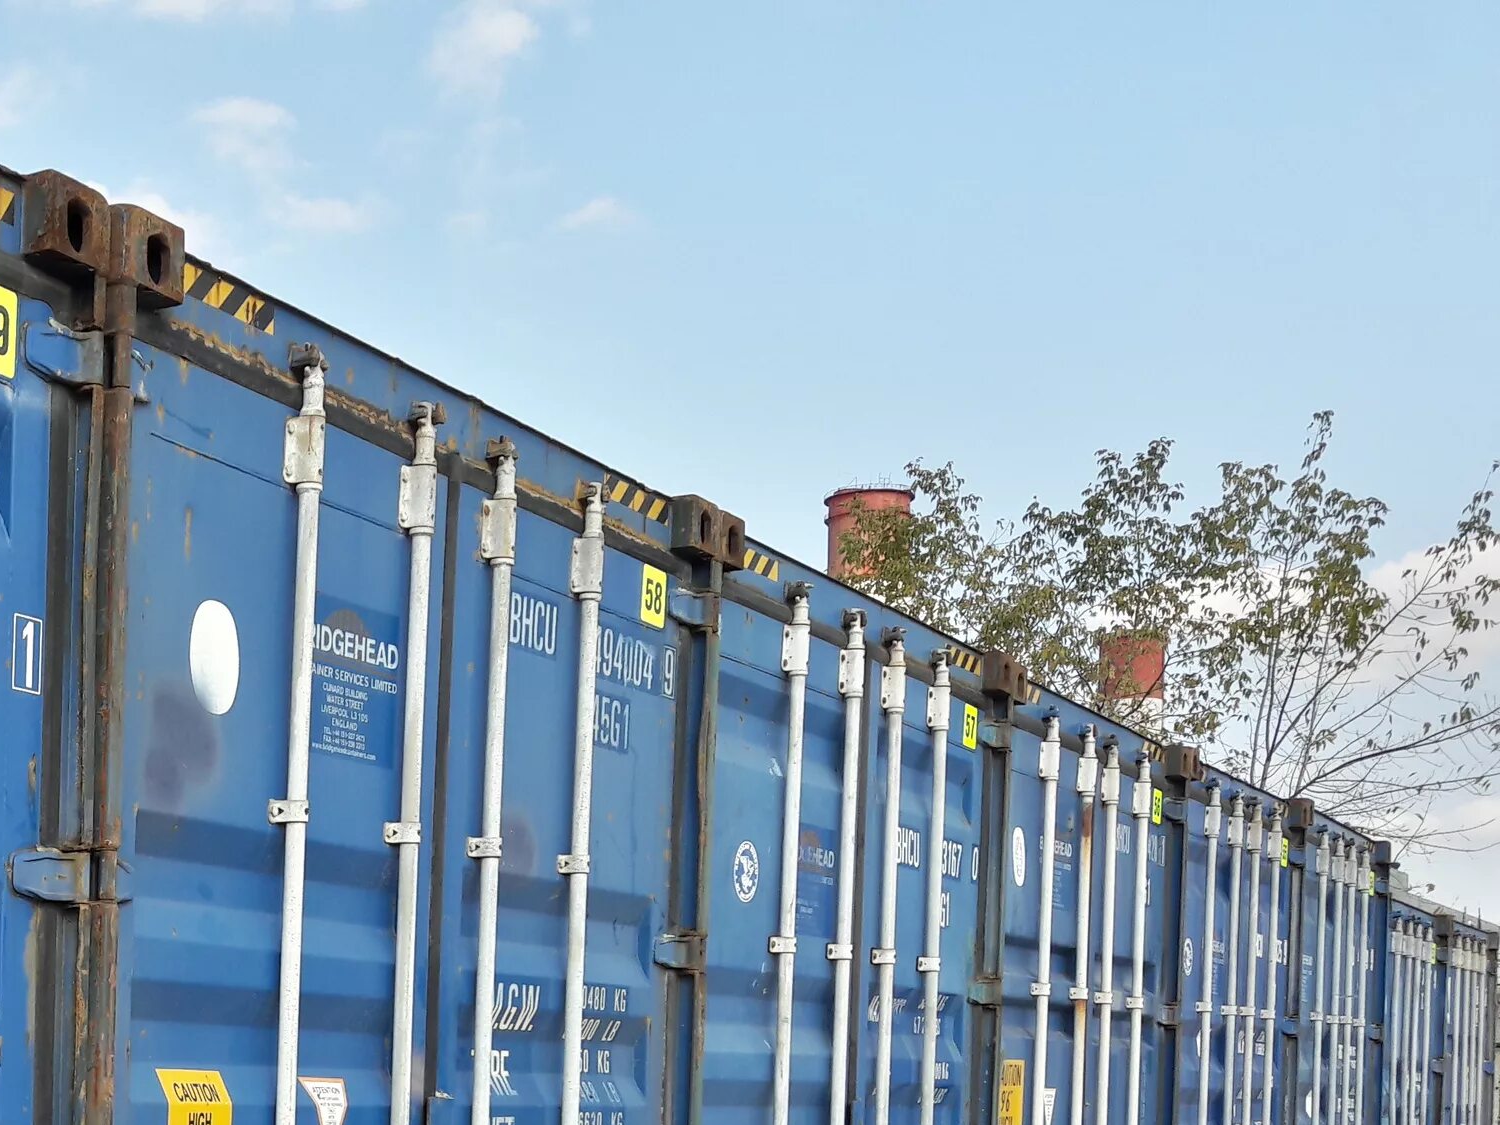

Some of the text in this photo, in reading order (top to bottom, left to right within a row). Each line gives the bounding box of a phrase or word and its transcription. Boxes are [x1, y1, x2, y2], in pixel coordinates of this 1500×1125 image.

[645, 578, 663, 615] 58
[509, 591, 558, 655] BHCU
[312, 623, 399, 670] RIDGEHEAD
[312, 665, 398, 695] AINER SERVICES LIMITED
[322, 682, 369, 701] CUNARD BUILDING
[321, 704, 348, 719] LIVERPOOL
[326, 694, 365, 711] WATER STREET
[332, 718, 358, 731] ENGLAND
[965, 715, 975, 740] 57
[942, 840, 963, 879] 3167
[971, 846, 979, 881] 0
[582, 985, 606, 1011] 0480
[614, 988, 627, 1013] KG
[601, 1020, 621, 1042] LB
[597, 1050, 610, 1074] KG
[173, 1082, 221, 1103] CAUTION
